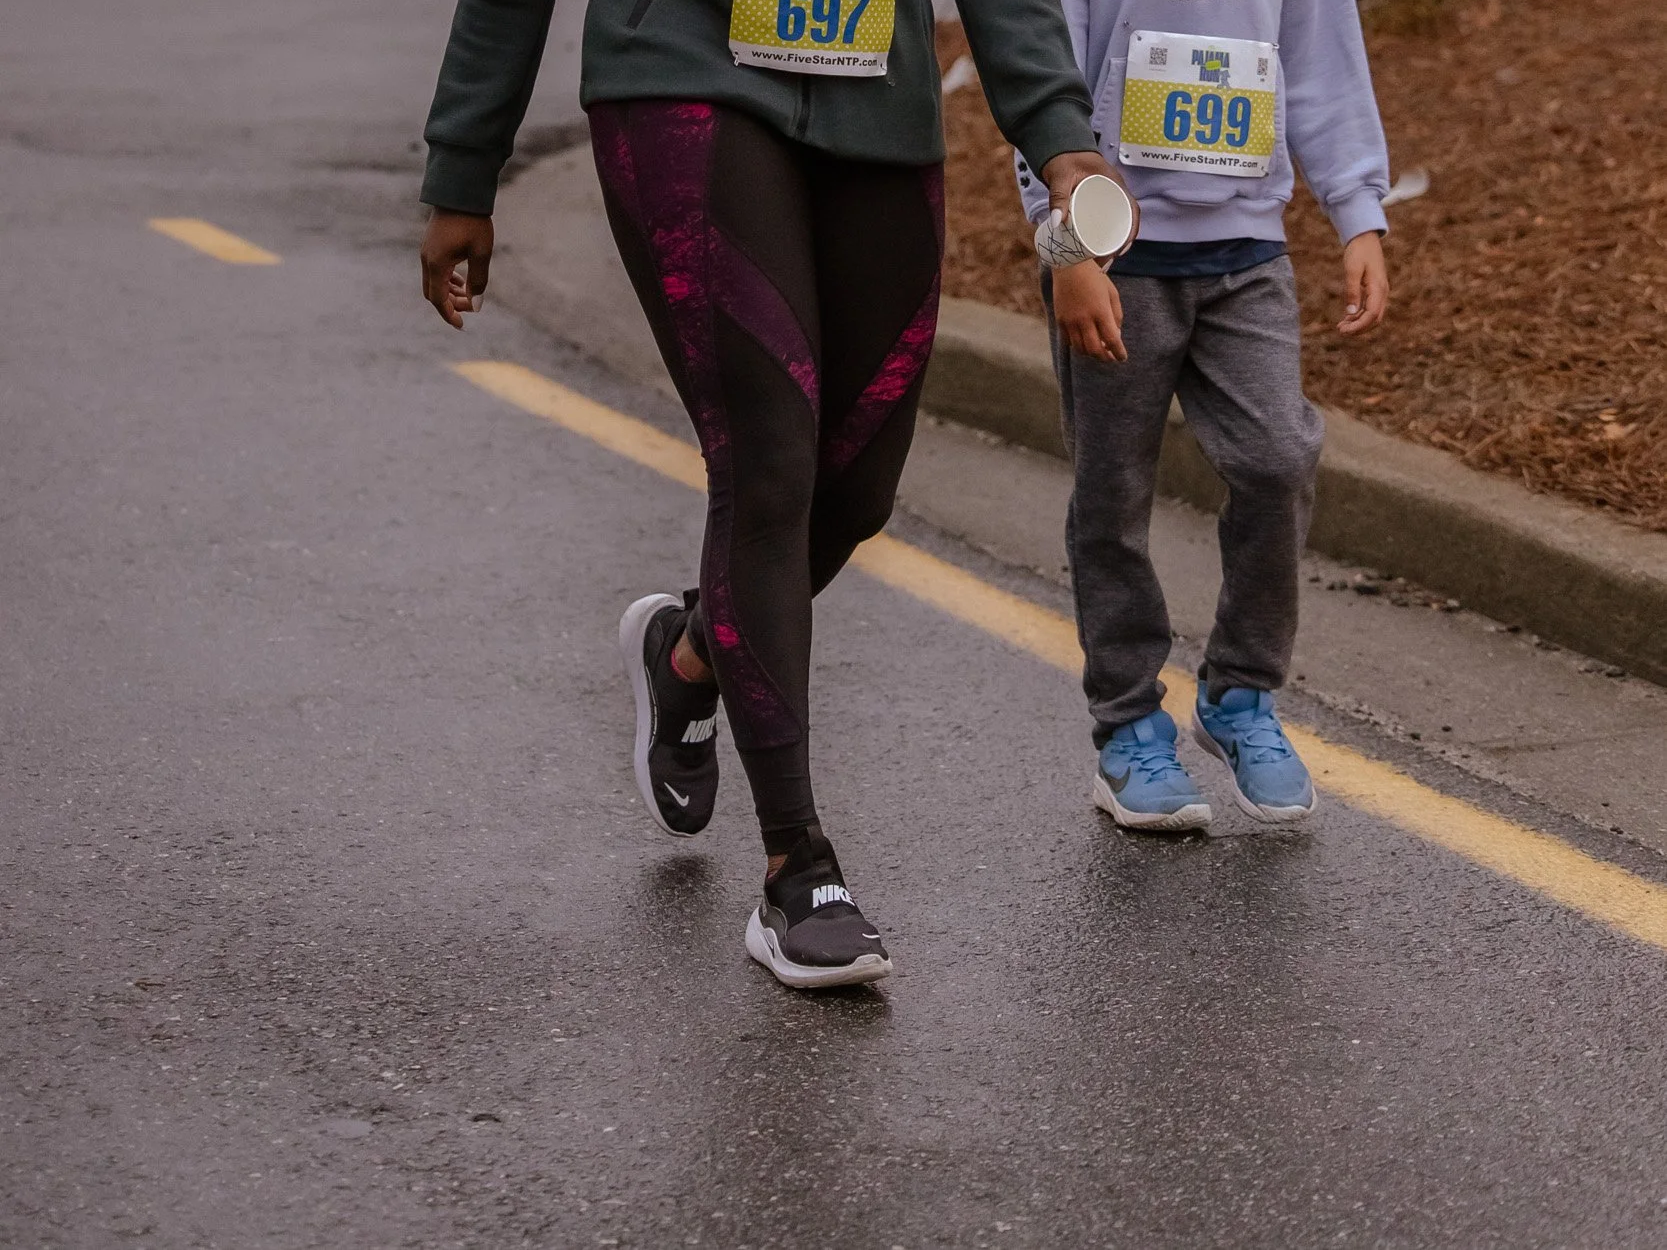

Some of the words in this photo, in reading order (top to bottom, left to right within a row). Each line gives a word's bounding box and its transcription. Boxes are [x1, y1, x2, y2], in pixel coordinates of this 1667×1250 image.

[752, 50, 878, 66] www.FiveStarNTP.com
[1199, 67, 1220, 82] RUN
[1163, 90, 1251, 148] 699
[1142, 151, 1257, 169] www.FiveStarNTP.com
[681, 713, 716, 743] NIK
